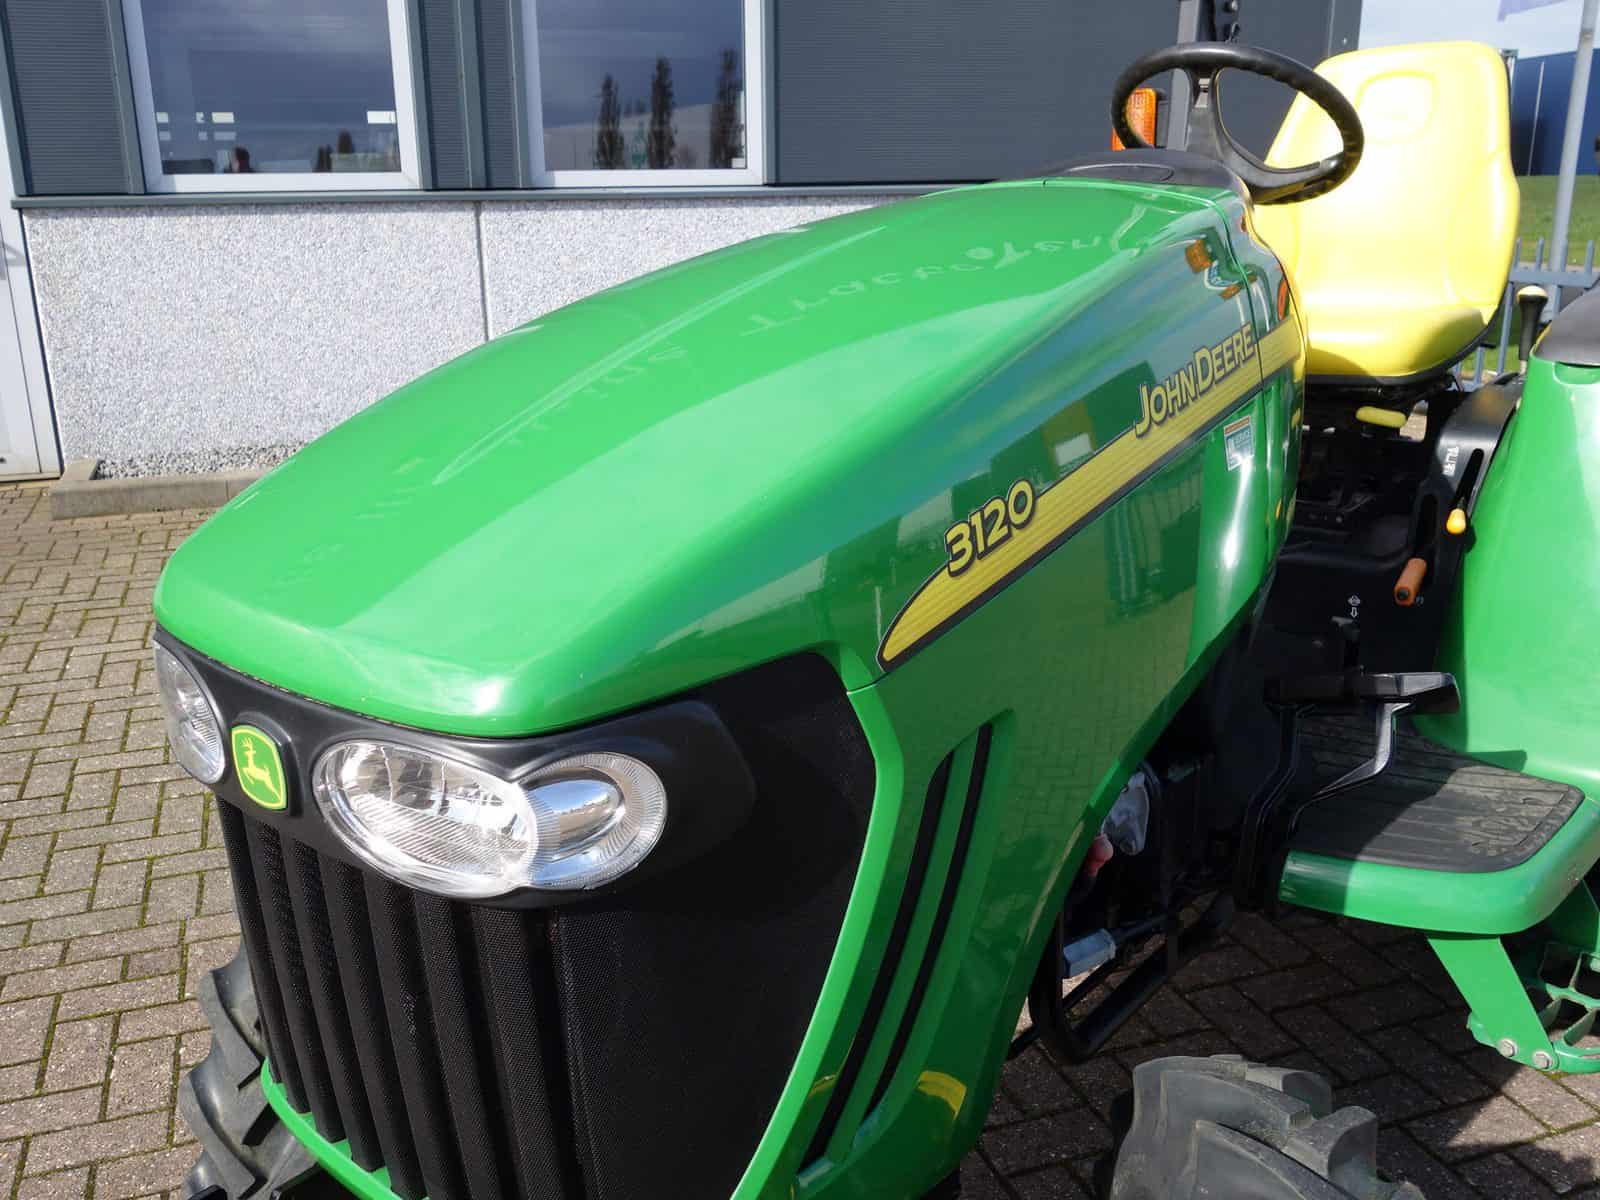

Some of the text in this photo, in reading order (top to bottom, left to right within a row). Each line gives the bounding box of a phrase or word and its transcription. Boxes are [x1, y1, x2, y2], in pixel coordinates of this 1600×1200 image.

[1135, 323, 1256, 438] JOHN DEERE
[945, 479, 1035, 577] 3120
